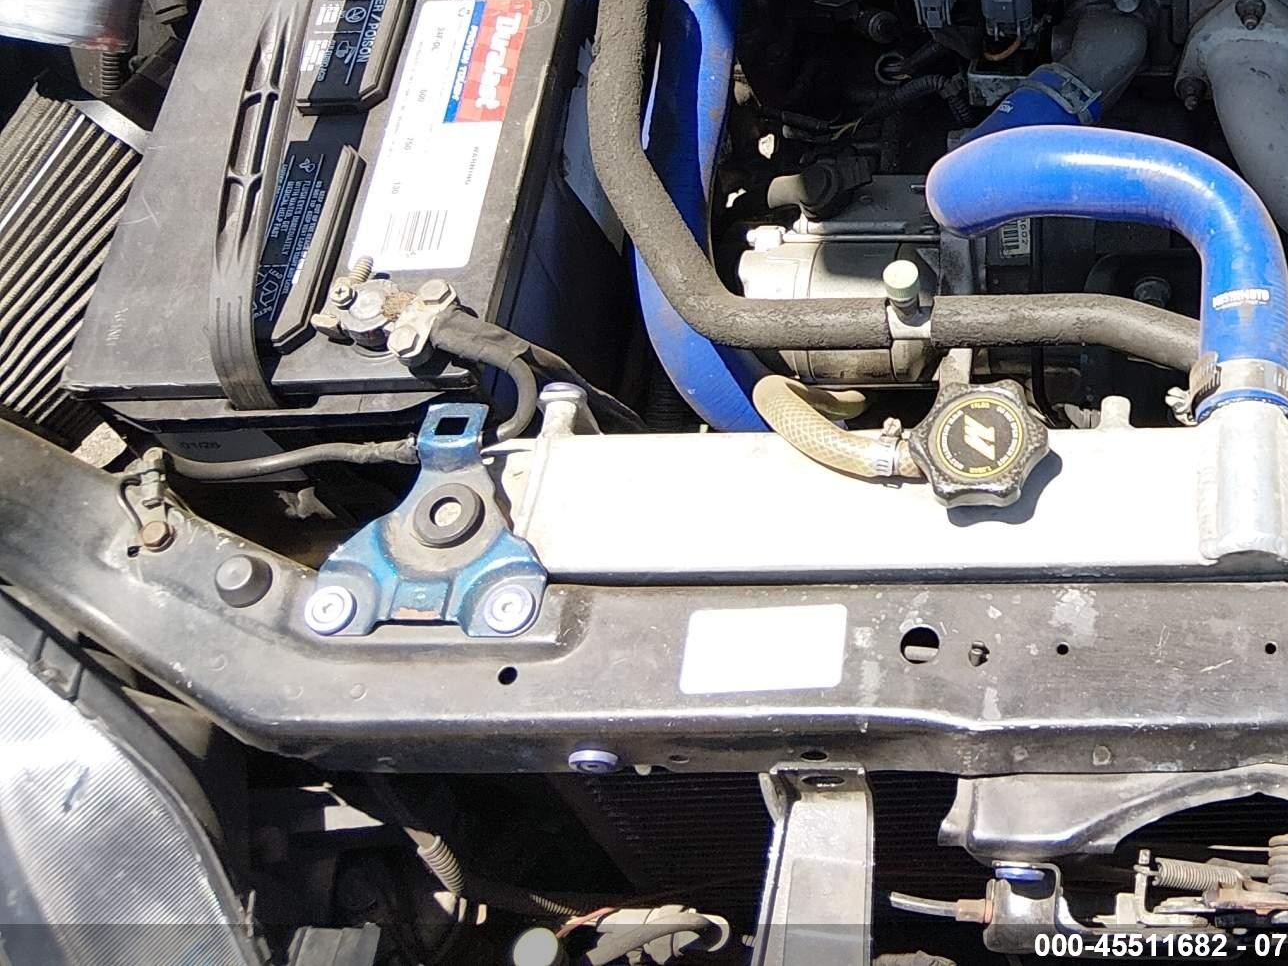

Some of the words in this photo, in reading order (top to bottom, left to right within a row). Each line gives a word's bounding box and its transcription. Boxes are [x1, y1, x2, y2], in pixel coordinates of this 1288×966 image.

[356, 22, 379, 62] POISON
[475, 13, 522, 108] Duralast
[464, 146, 480, 185] WARNING
[281, 180, 293, 205] MEDICAL
[292, 180, 302, 196] WITH
[299, 179, 310, 198] FLUSH
[274, 206, 285, 222] HELP
[294, 198, 304, 215] EYES
[269, 222, 280, 238] FAST
[280, 219, 289, 233] GET
[281, 214, 300, 256] IMMEDIATELY
